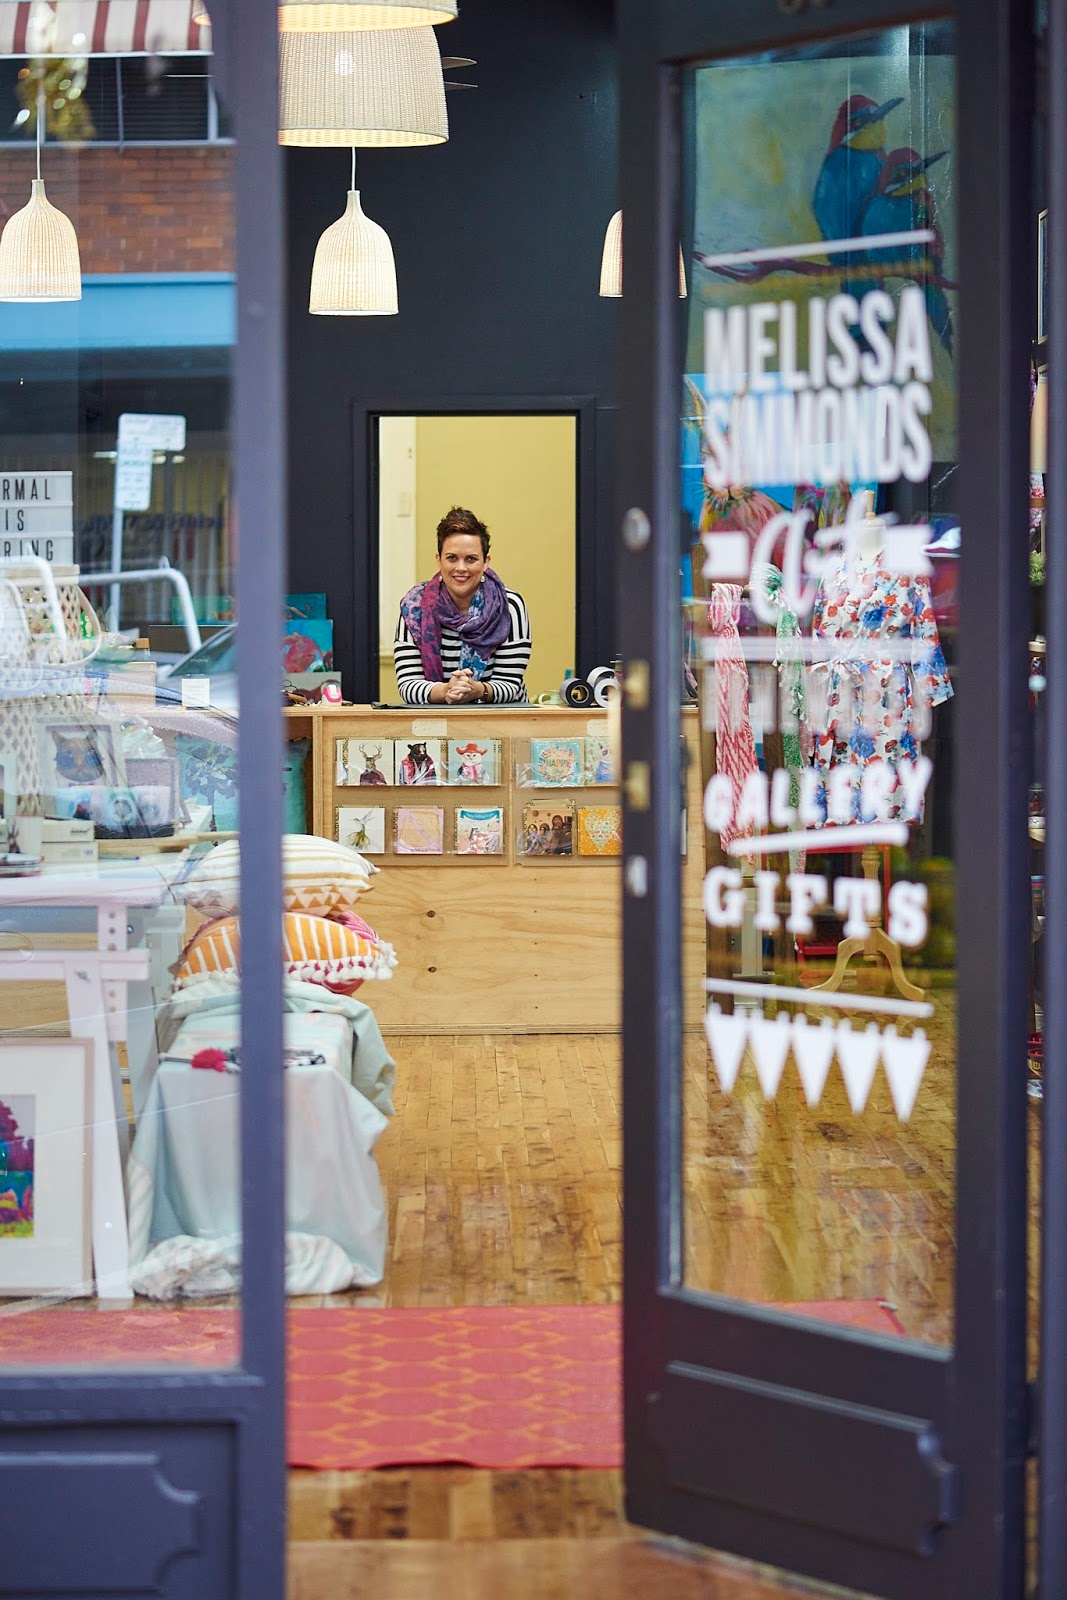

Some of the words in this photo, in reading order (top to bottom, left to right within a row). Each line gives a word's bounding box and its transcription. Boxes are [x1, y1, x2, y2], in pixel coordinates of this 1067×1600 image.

[704, 286, 933, 393] MELISSA
[704, 381, 933, 490] SIMMONDS
[5, 509, 24, 531] IS
[703, 755, 933, 834] GALLERY
[703, 864, 930, 948] GIFTS
